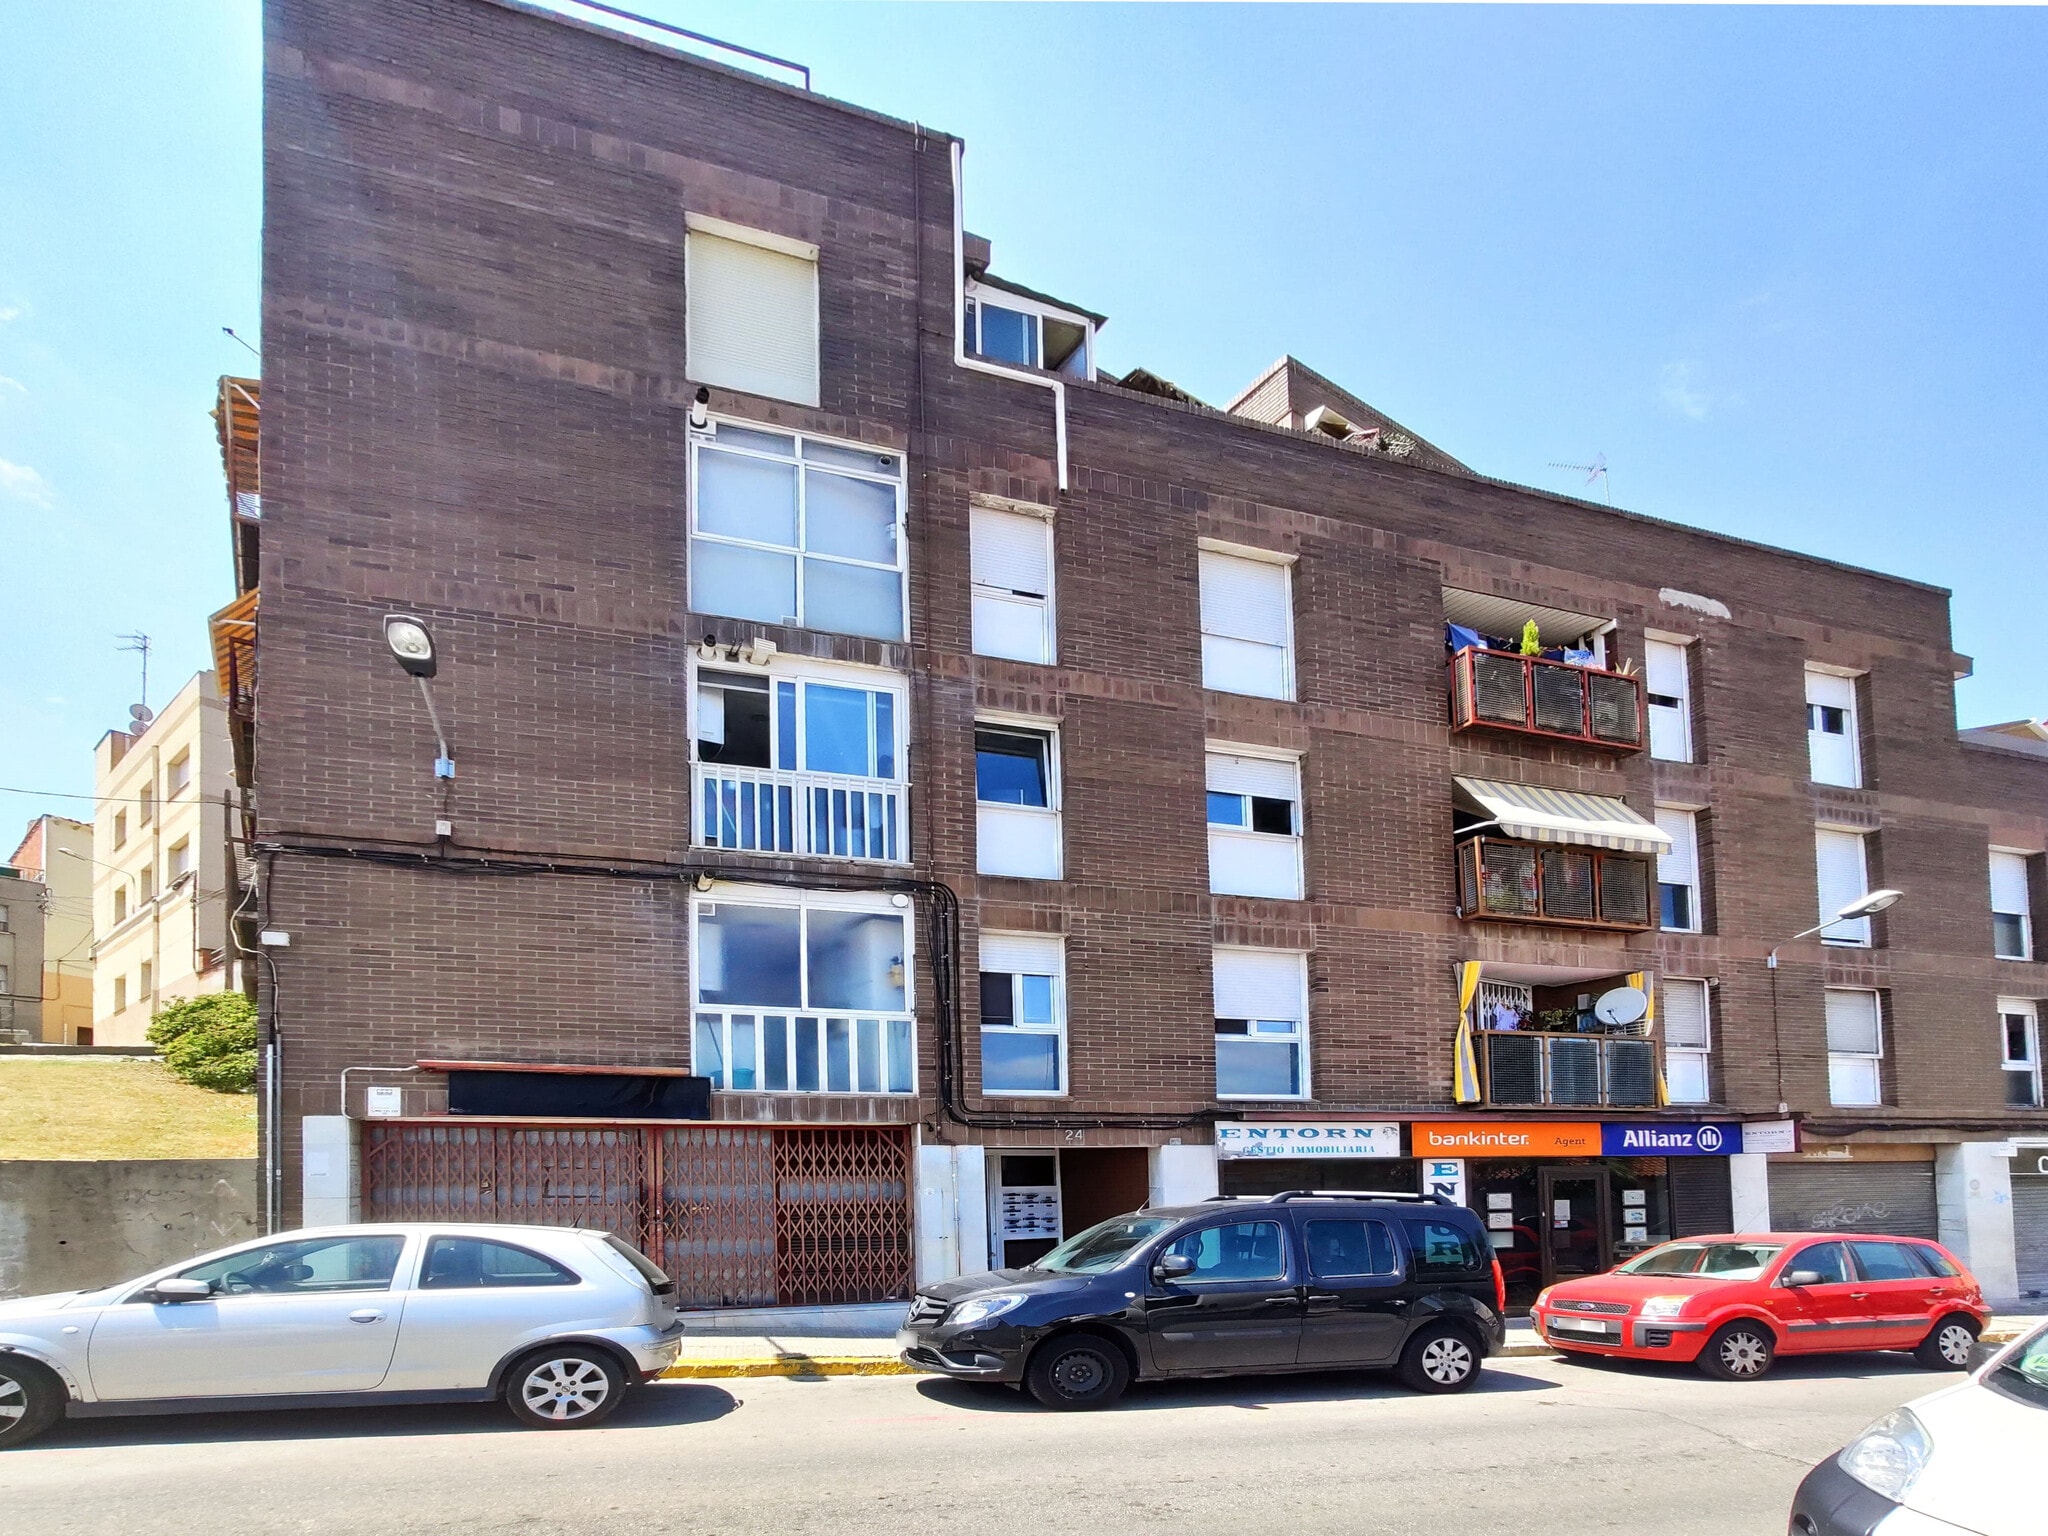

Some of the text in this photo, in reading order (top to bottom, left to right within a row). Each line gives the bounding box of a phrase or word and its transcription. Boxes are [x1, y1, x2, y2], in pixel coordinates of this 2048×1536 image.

[1065, 1129, 1083, 1140] 24
[1218, 1128, 1375, 1139] ENTORN
[1623, 1129, 1693, 1147] Allianz
[1554, 1137, 1586, 1147] Agent
[1242, 1143, 1375, 1154] GESTIÓ IMMOBILIARIA
